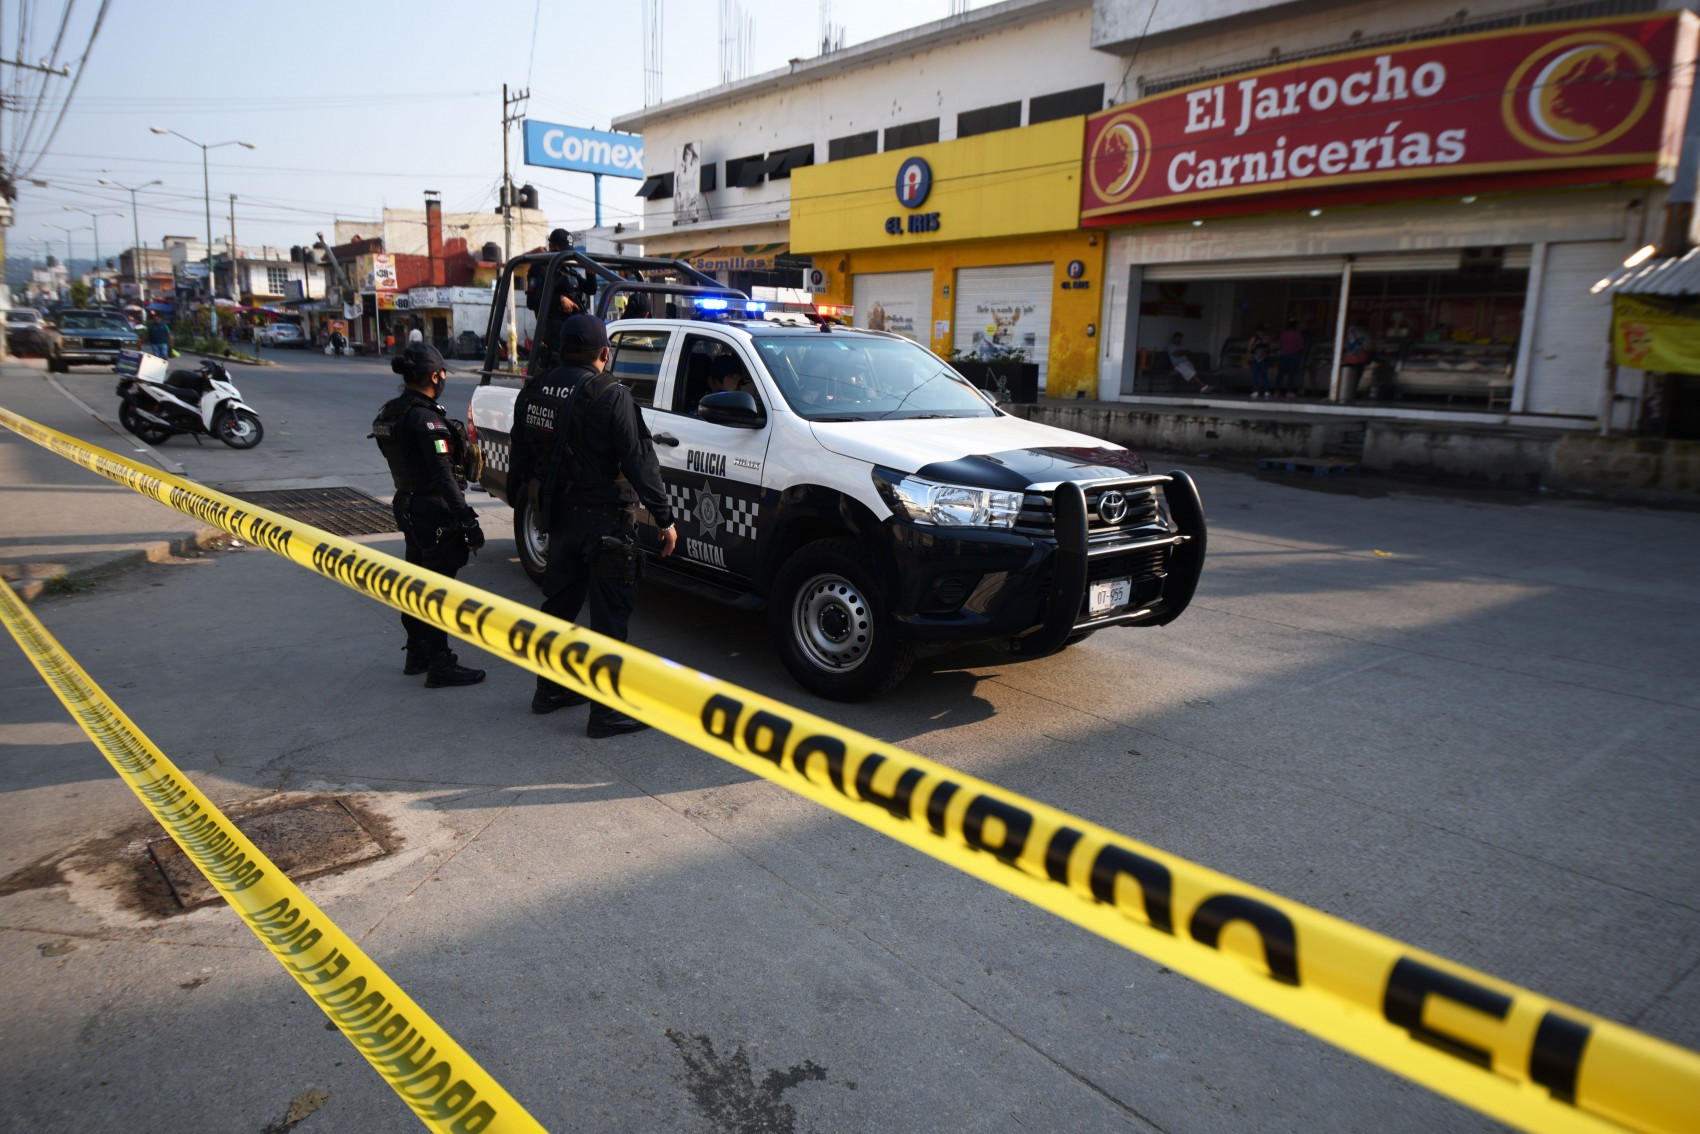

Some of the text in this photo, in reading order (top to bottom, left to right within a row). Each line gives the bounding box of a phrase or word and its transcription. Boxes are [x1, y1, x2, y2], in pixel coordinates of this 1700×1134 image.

[1185, 54, 1447, 137] El Jarocho
[543, 128, 643, 170] Comex
[1167, 121, 1467, 193] Carnicerías
[885, 212, 941, 235] EL IRIS
[697, 257, 766, 271] Semillas
[525, 414, 554, 430] ESTATAL
[527, 403, 555, 420] POLICIA
[687, 449, 727, 477] POLICIA
[686, 537, 728, 568] ESTATAL
